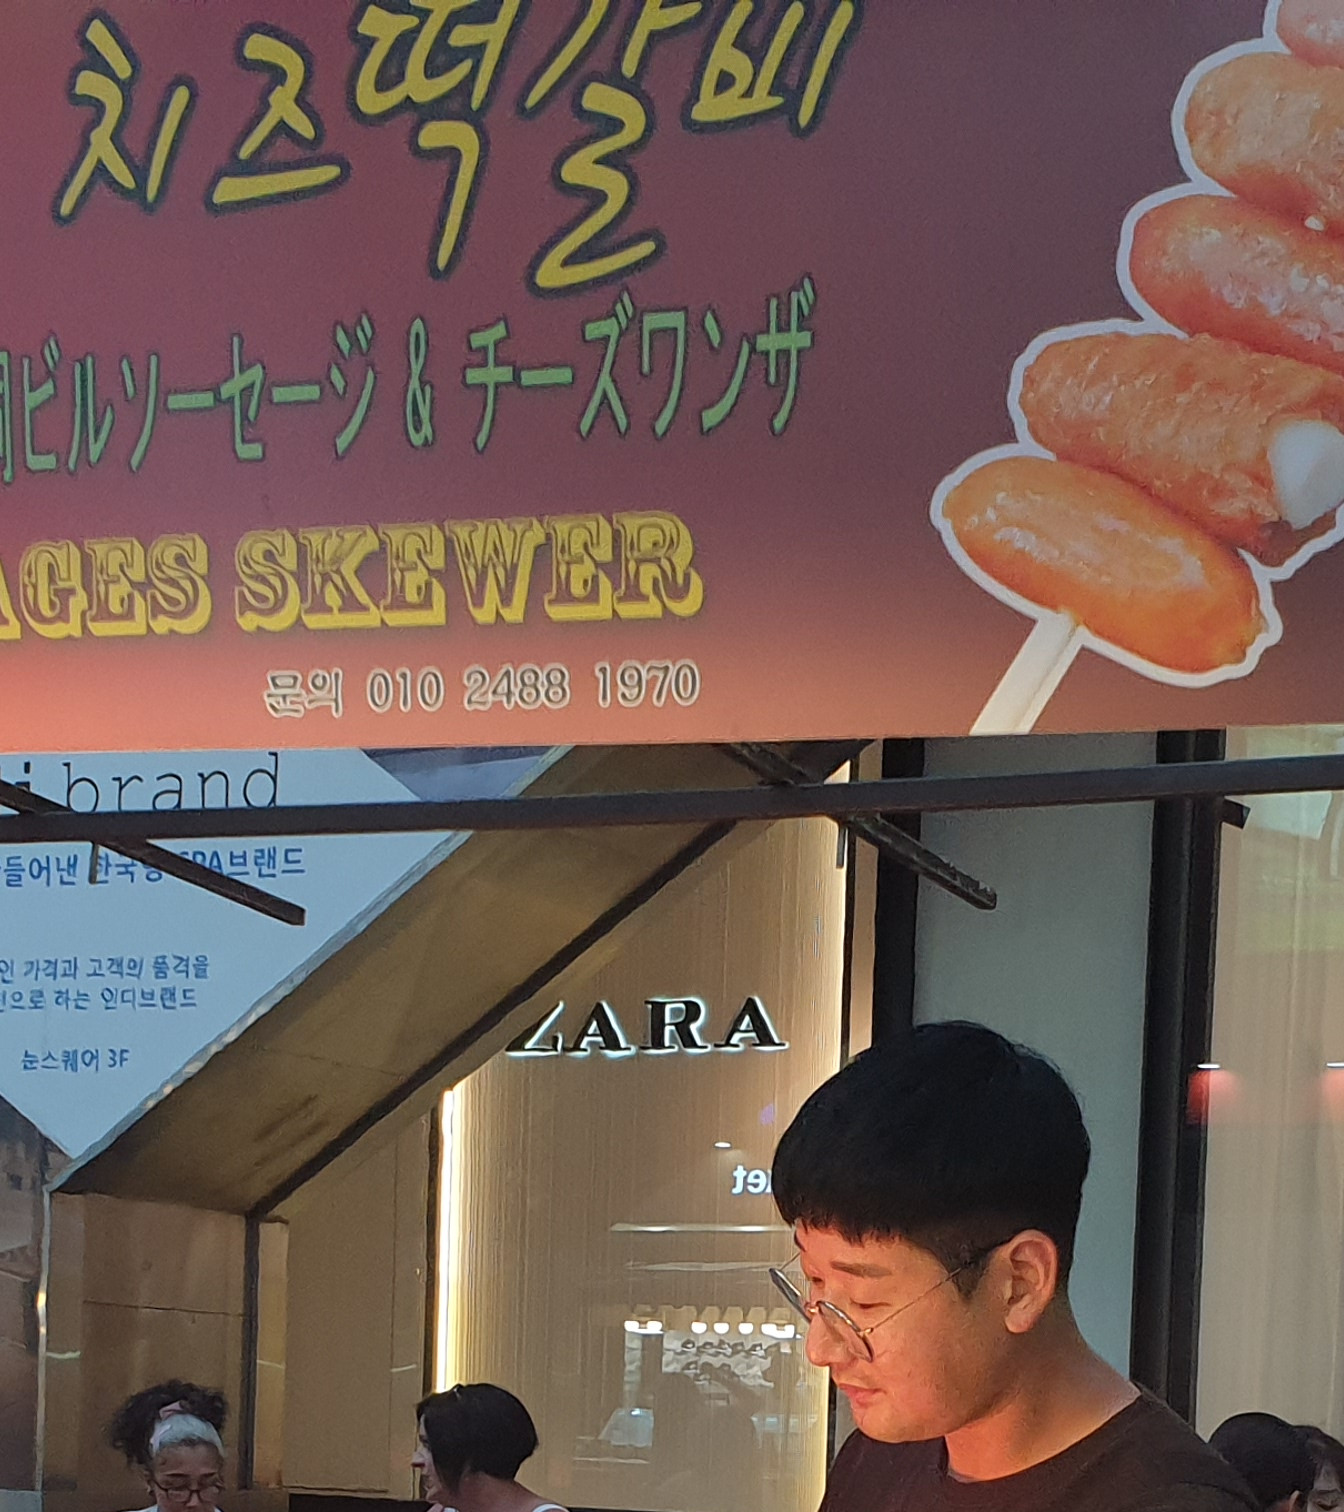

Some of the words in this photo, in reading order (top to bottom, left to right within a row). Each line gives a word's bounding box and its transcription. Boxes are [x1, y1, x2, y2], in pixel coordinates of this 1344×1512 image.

[59, 0, 858, 294] 치즈떡갈비
[405, 317, 433, 448] &
[463, 275, 817, 452] チーズワンザ
[234, 511, 703, 631] SKEWER
[262, 666, 344, 717] 문의
[367, 664, 445, 712] 010
[464, 662, 570, 709] 2488
[595, 658, 700, 708] 1970
[62, 752, 279, 814] brand
[179, 846, 306, 878] PA브랜드
[23, 957, 79, 981] 가격과
[86, 956, 144, 979] 고객의
[153, 955, 210, 980] 품격을
[53, 987, 90, 1011] 하는
[100, 986, 198, 1011] 인디브랜드
[506, 997, 789, 1057] ZARA
[21, 1049, 100, 1072] 눈스퀘어
[107, 1049, 129, 1068] 3F
